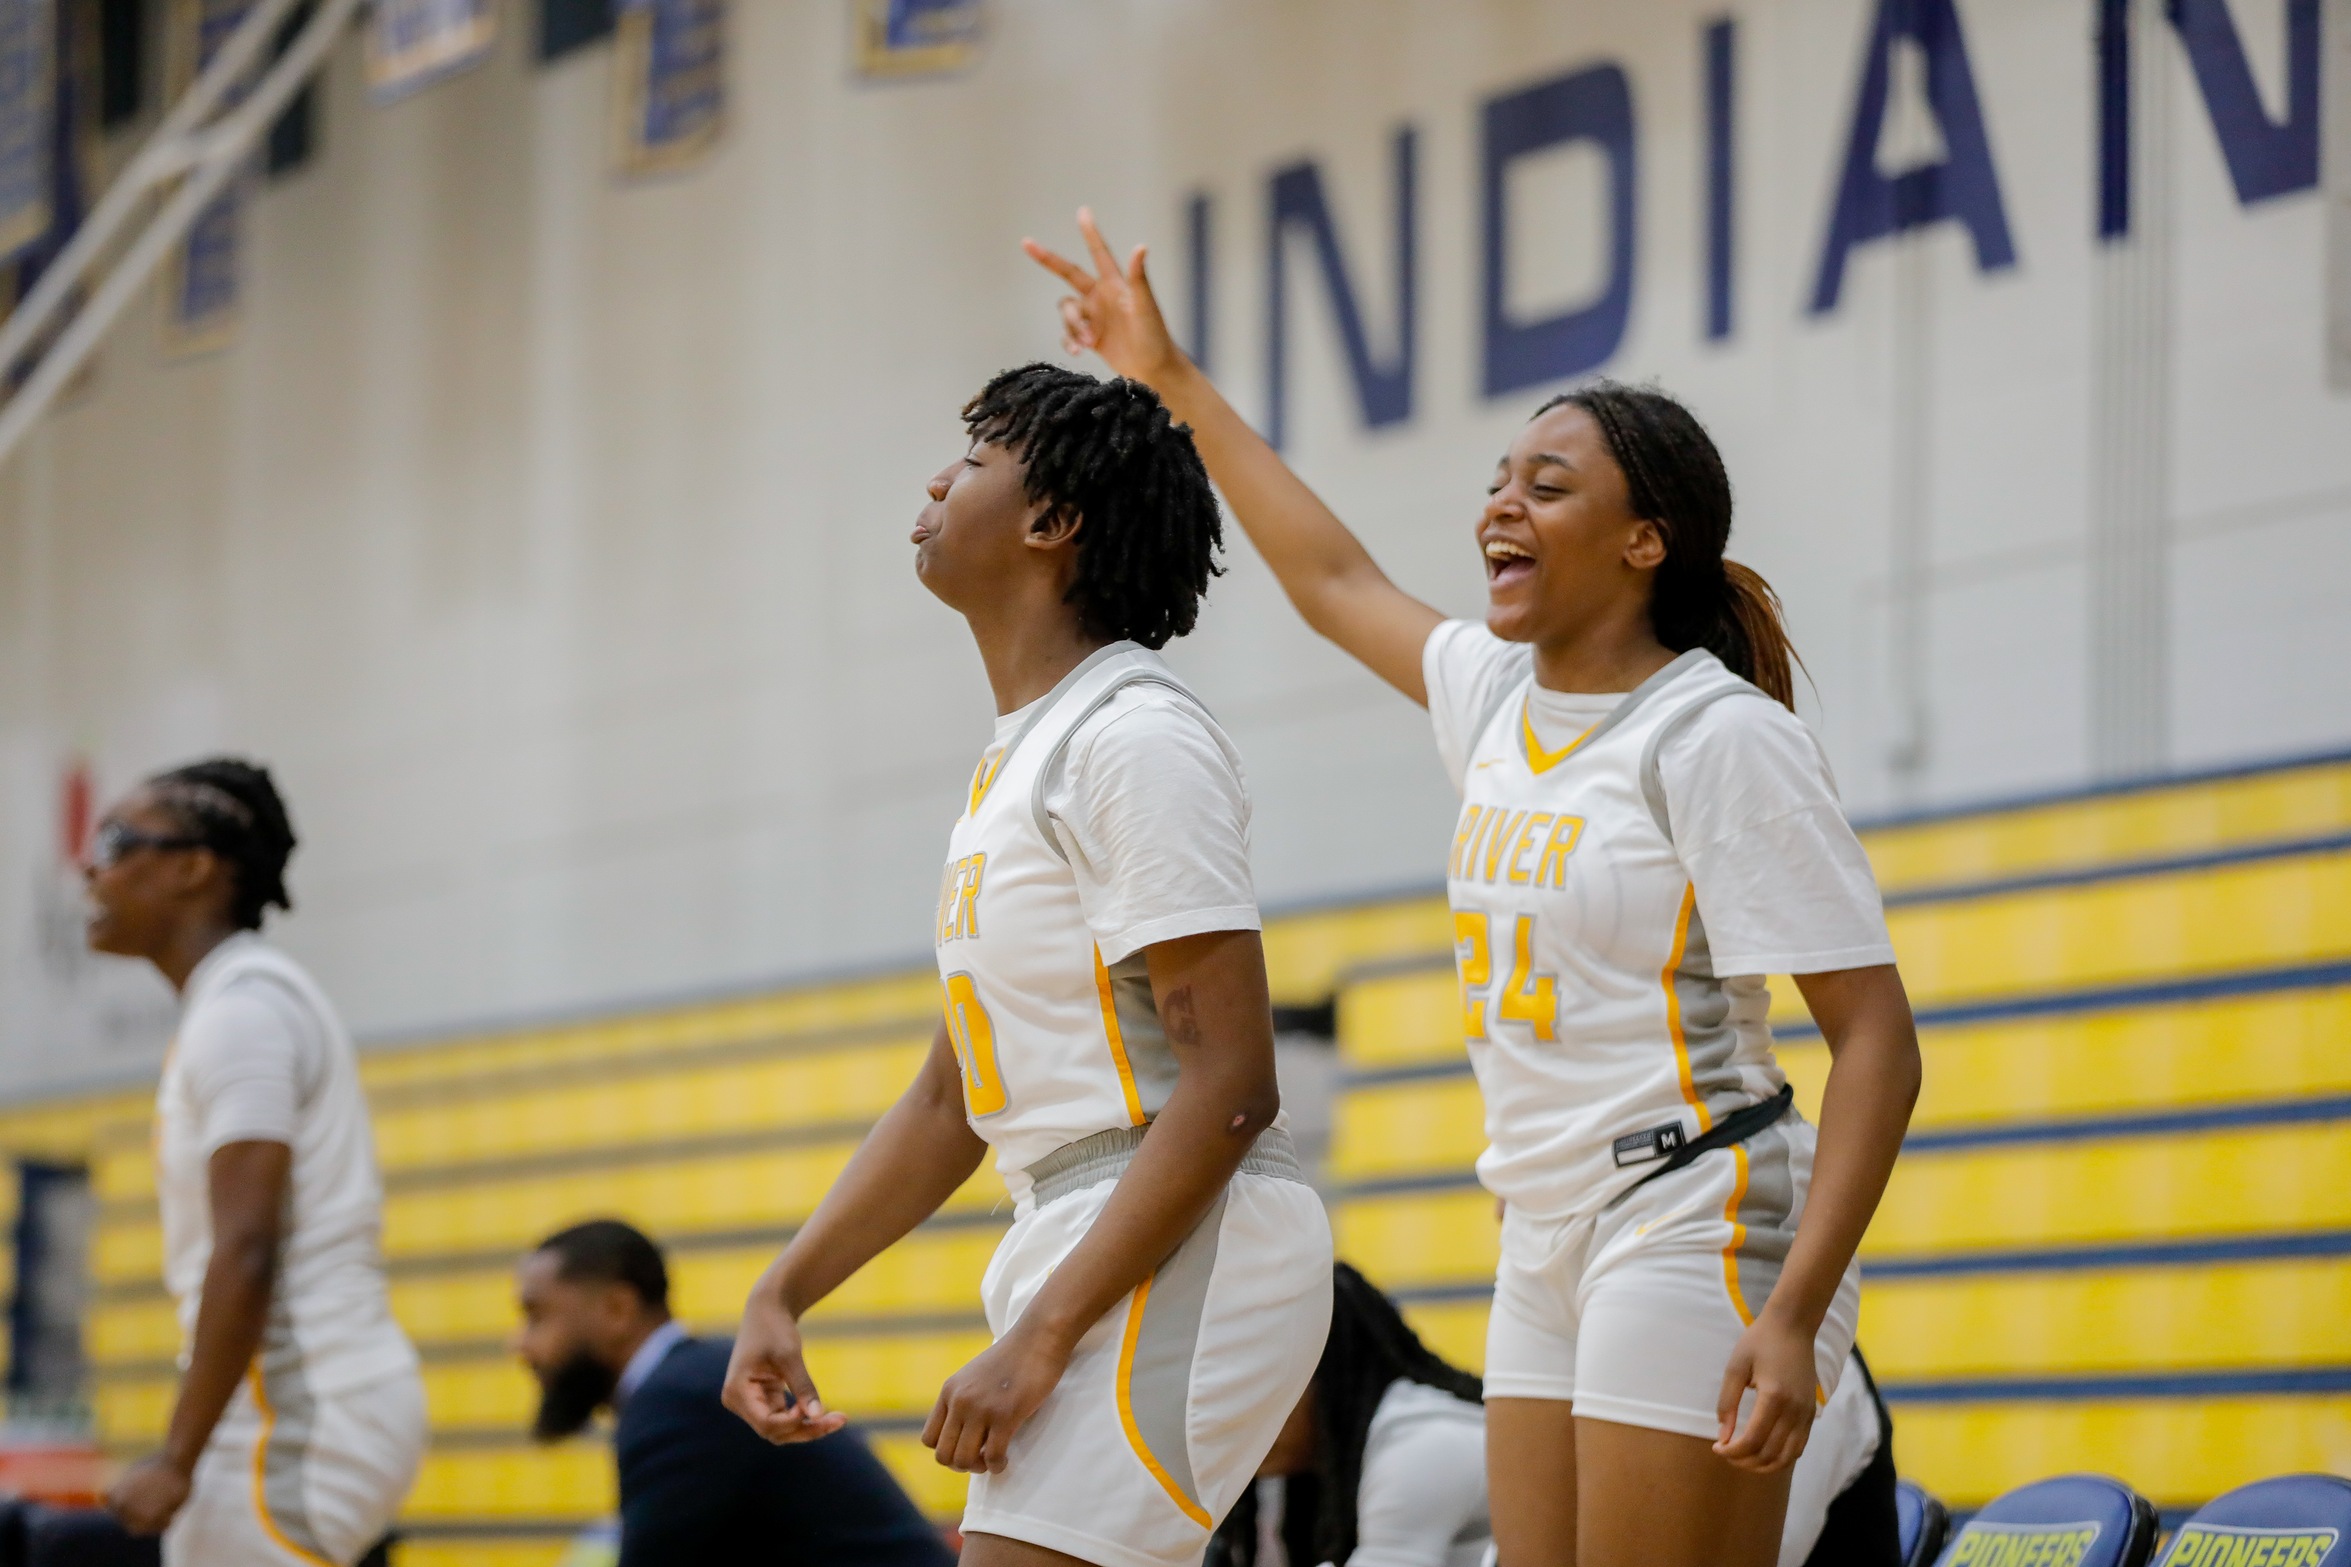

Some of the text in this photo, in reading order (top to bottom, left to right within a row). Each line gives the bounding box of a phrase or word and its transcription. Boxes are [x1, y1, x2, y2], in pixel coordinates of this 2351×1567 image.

[1187, 0, 2322, 460] INDIAN
[1447, 804, 1587, 891] RIVER
[1452, 909, 1562, 1044] 24
[941, 969, 1011, 1119] 0
[1661, 1131, 1677, 1150] M
[1946, 1530, 2096, 1567] PIONEERS
[2164, 1531, 2332, 1567] PIONEERS
